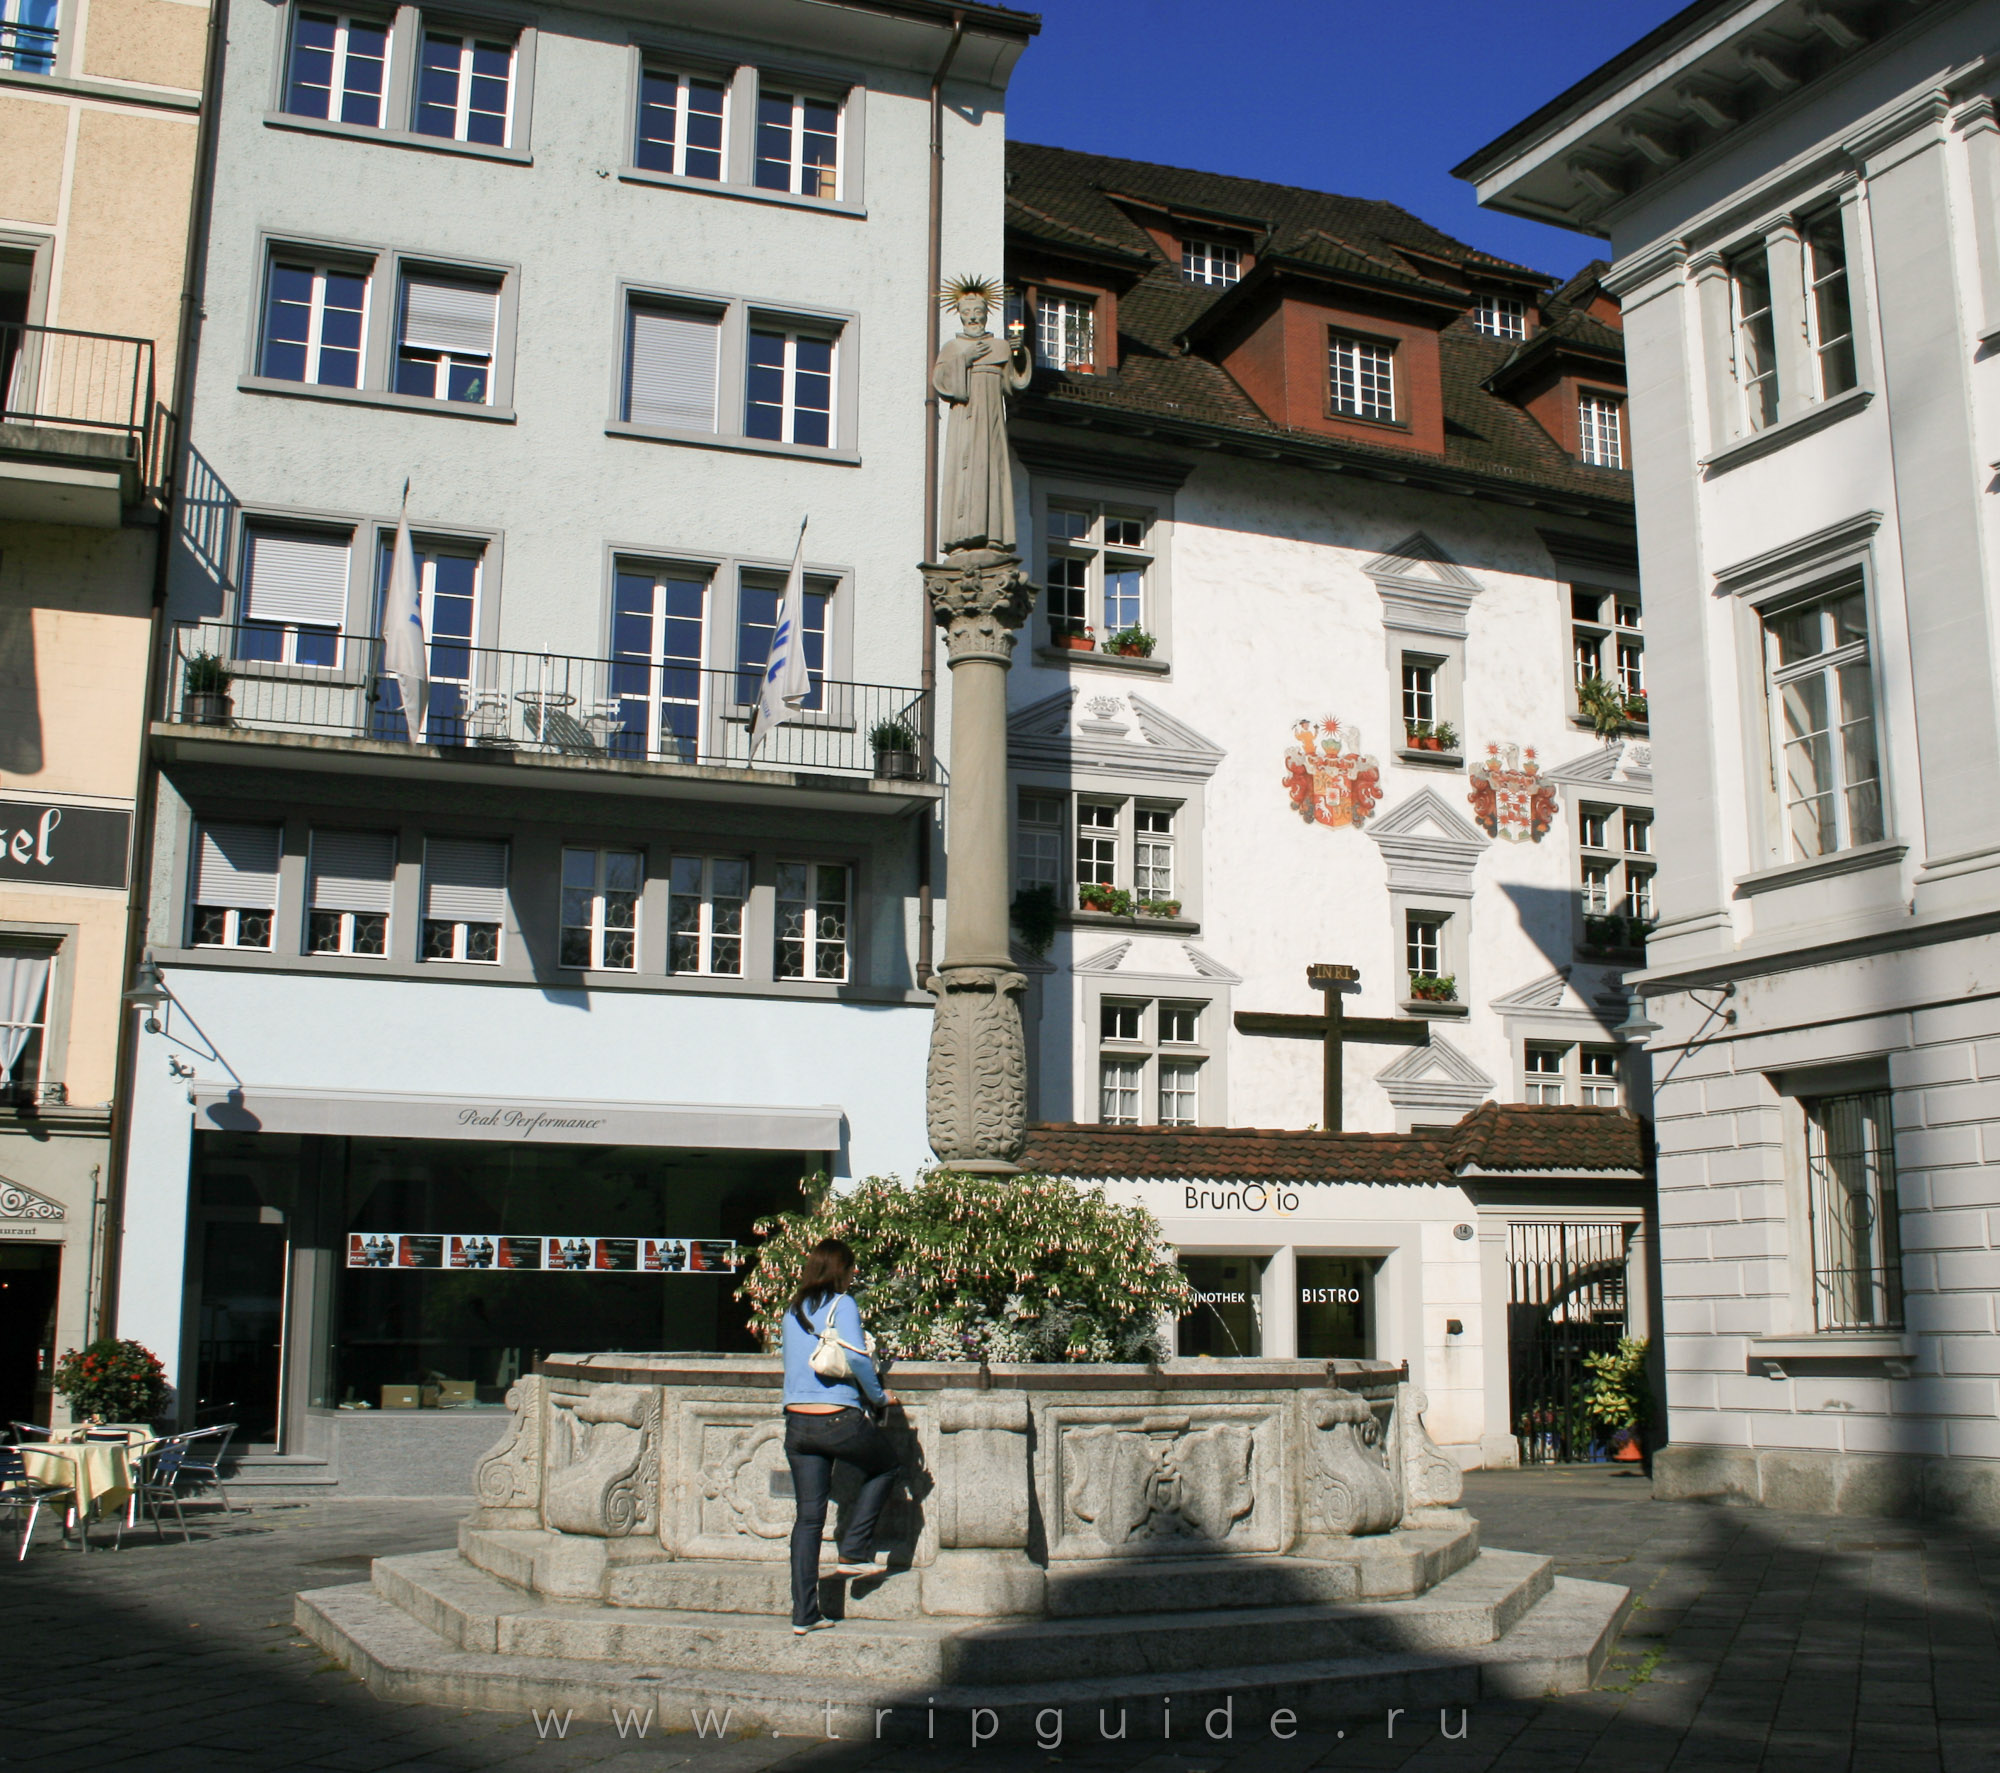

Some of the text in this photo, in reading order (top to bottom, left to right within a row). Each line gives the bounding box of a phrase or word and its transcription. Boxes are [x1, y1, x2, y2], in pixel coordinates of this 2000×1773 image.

[1315, 965, 1352, 980] INRI
[458, 1108, 602, 1138] Peak Performance
[1459, 1226, 1468, 1234] 14
[1302, 1288, 1360, 1303] BISTRO
